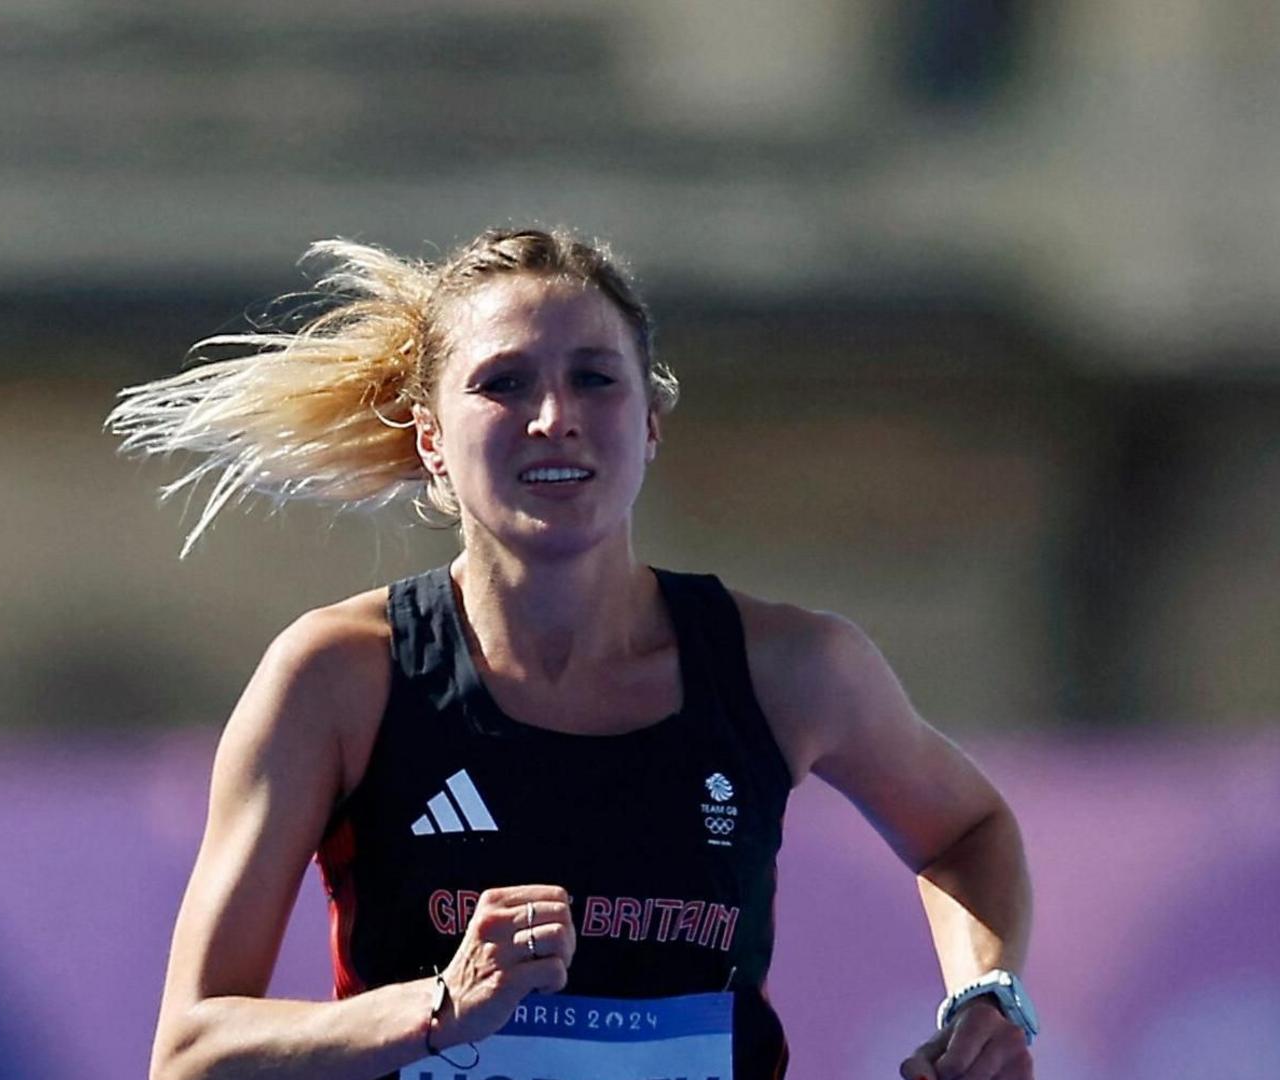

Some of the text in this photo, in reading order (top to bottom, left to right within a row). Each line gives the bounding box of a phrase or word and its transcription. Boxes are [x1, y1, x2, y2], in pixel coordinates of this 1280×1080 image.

[700, 803, 738, 816] TEAM GB
[581, 896, 740, 951] BRITAIN
[514, 1005, 658, 1030] ARIS 2024
